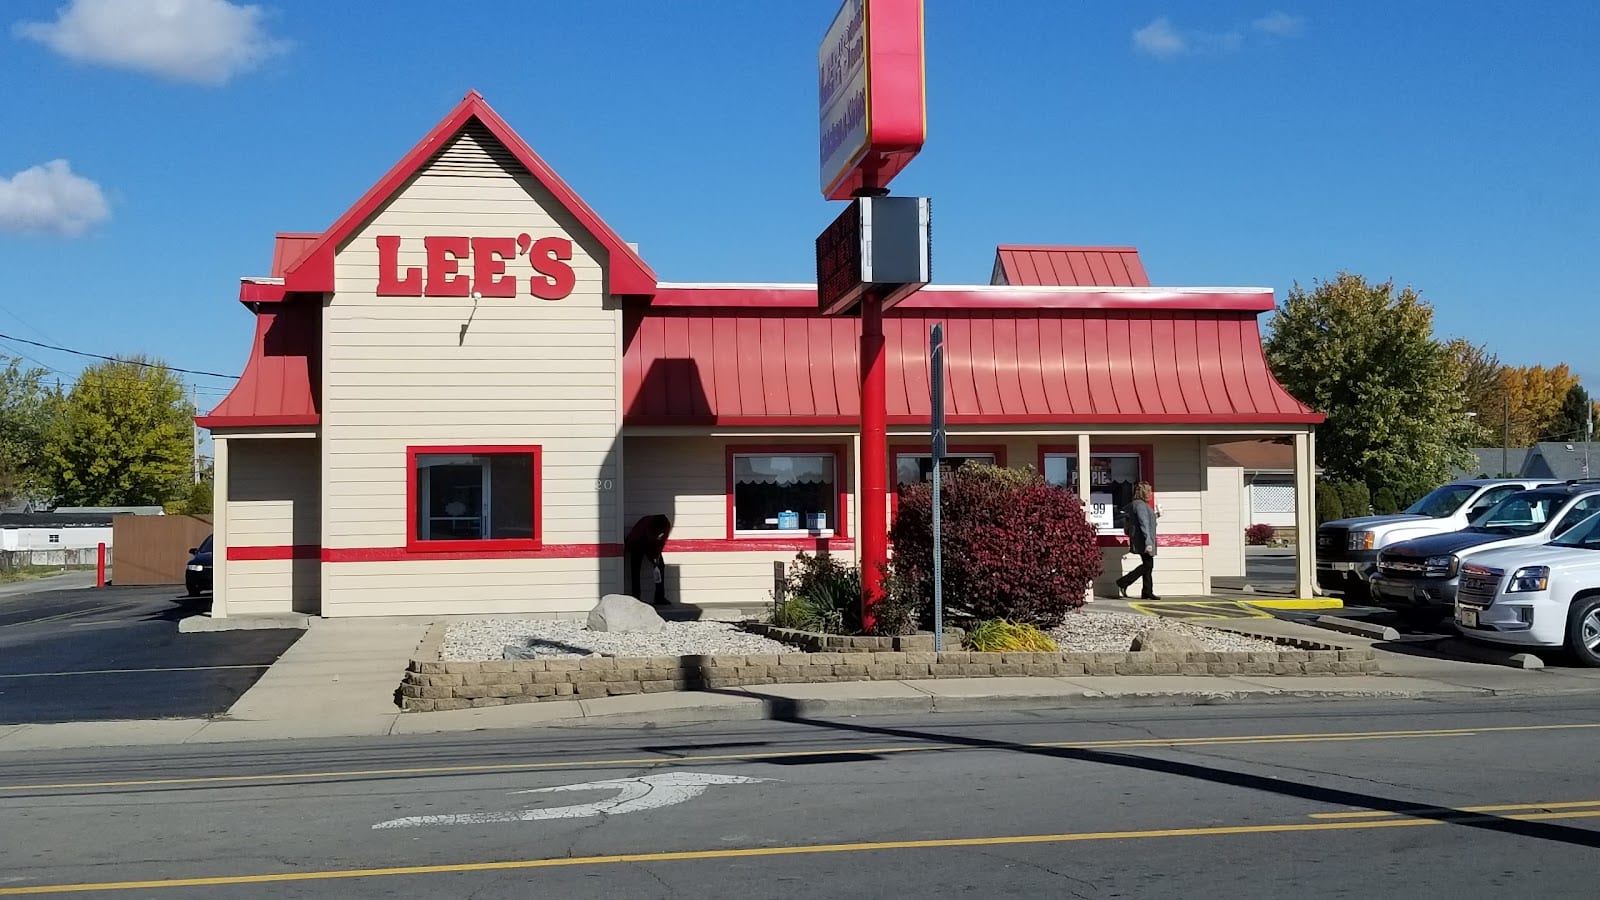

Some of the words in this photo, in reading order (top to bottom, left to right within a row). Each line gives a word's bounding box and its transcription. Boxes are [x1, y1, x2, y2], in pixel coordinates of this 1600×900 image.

[376, 232, 576, 300] LEE'S
[1091, 471, 1107, 485] PIE
[1090, 503, 1106, 515] .99
